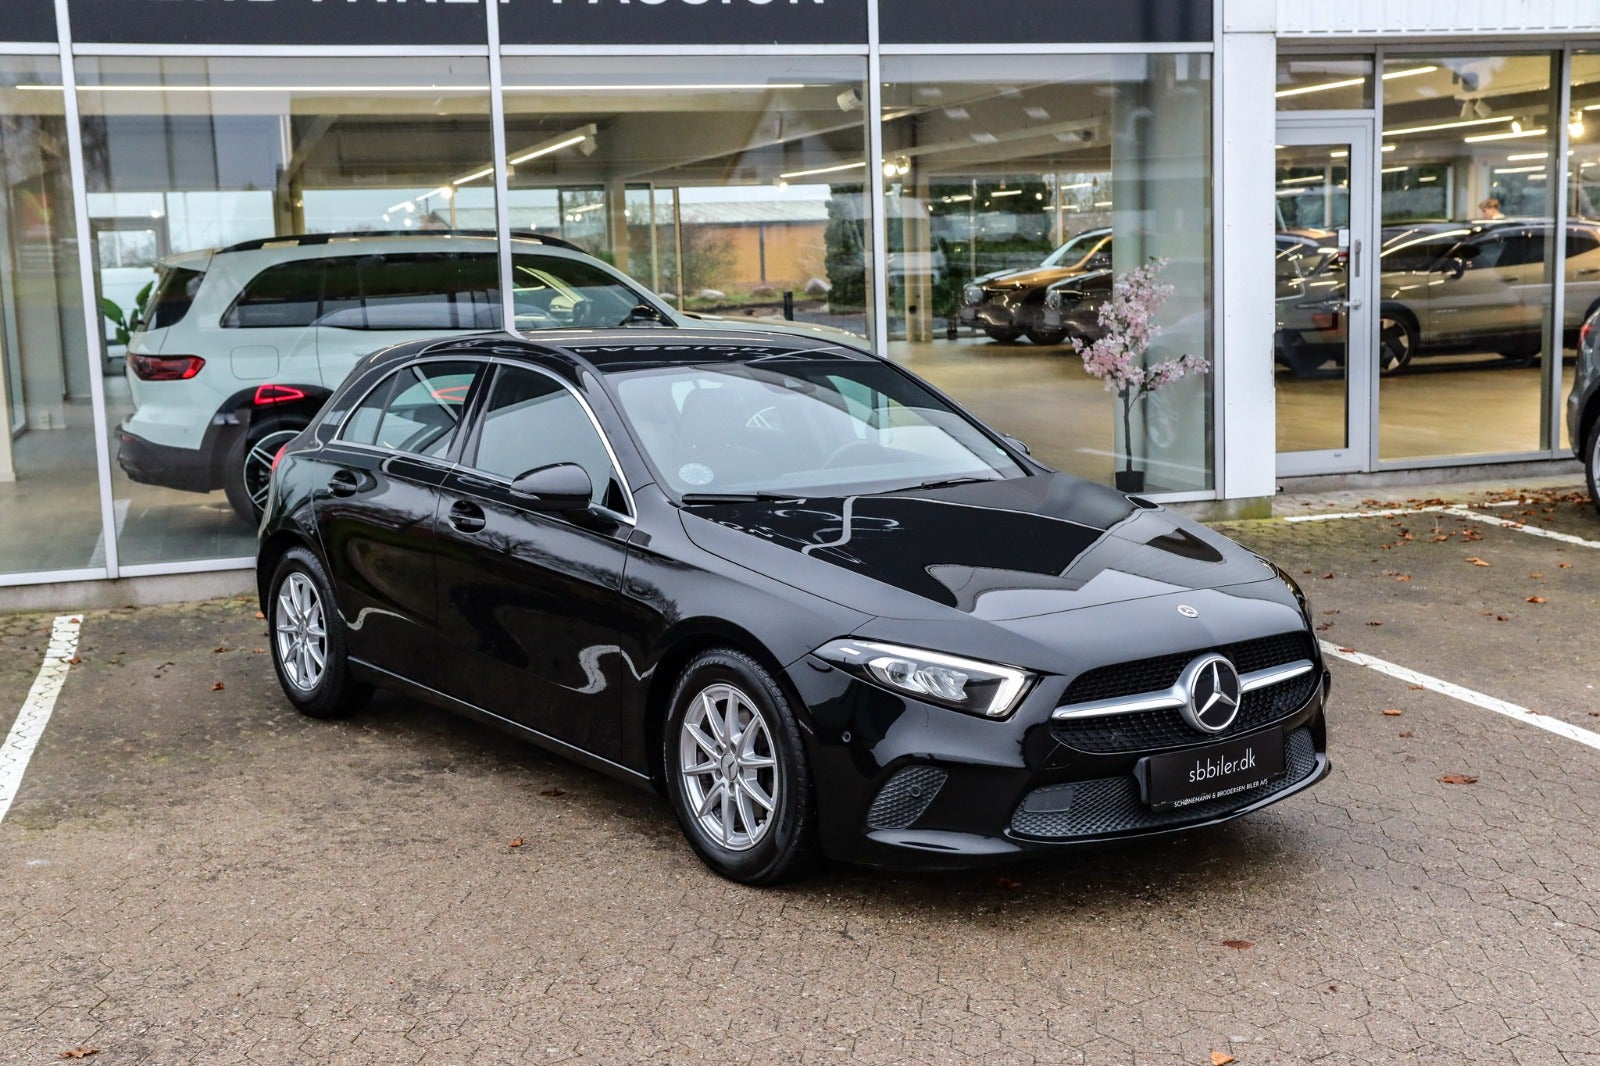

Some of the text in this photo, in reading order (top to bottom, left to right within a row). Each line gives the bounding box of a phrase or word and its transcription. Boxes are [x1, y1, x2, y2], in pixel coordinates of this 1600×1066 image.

[1189, 747, 1256, 782] sbbiler.dk
[1173, 793, 1211, 807] SCHØNEMANN
[1216, 785, 1246, 798] BRODERSEN
[1246, 780, 1260, 790] BILER
